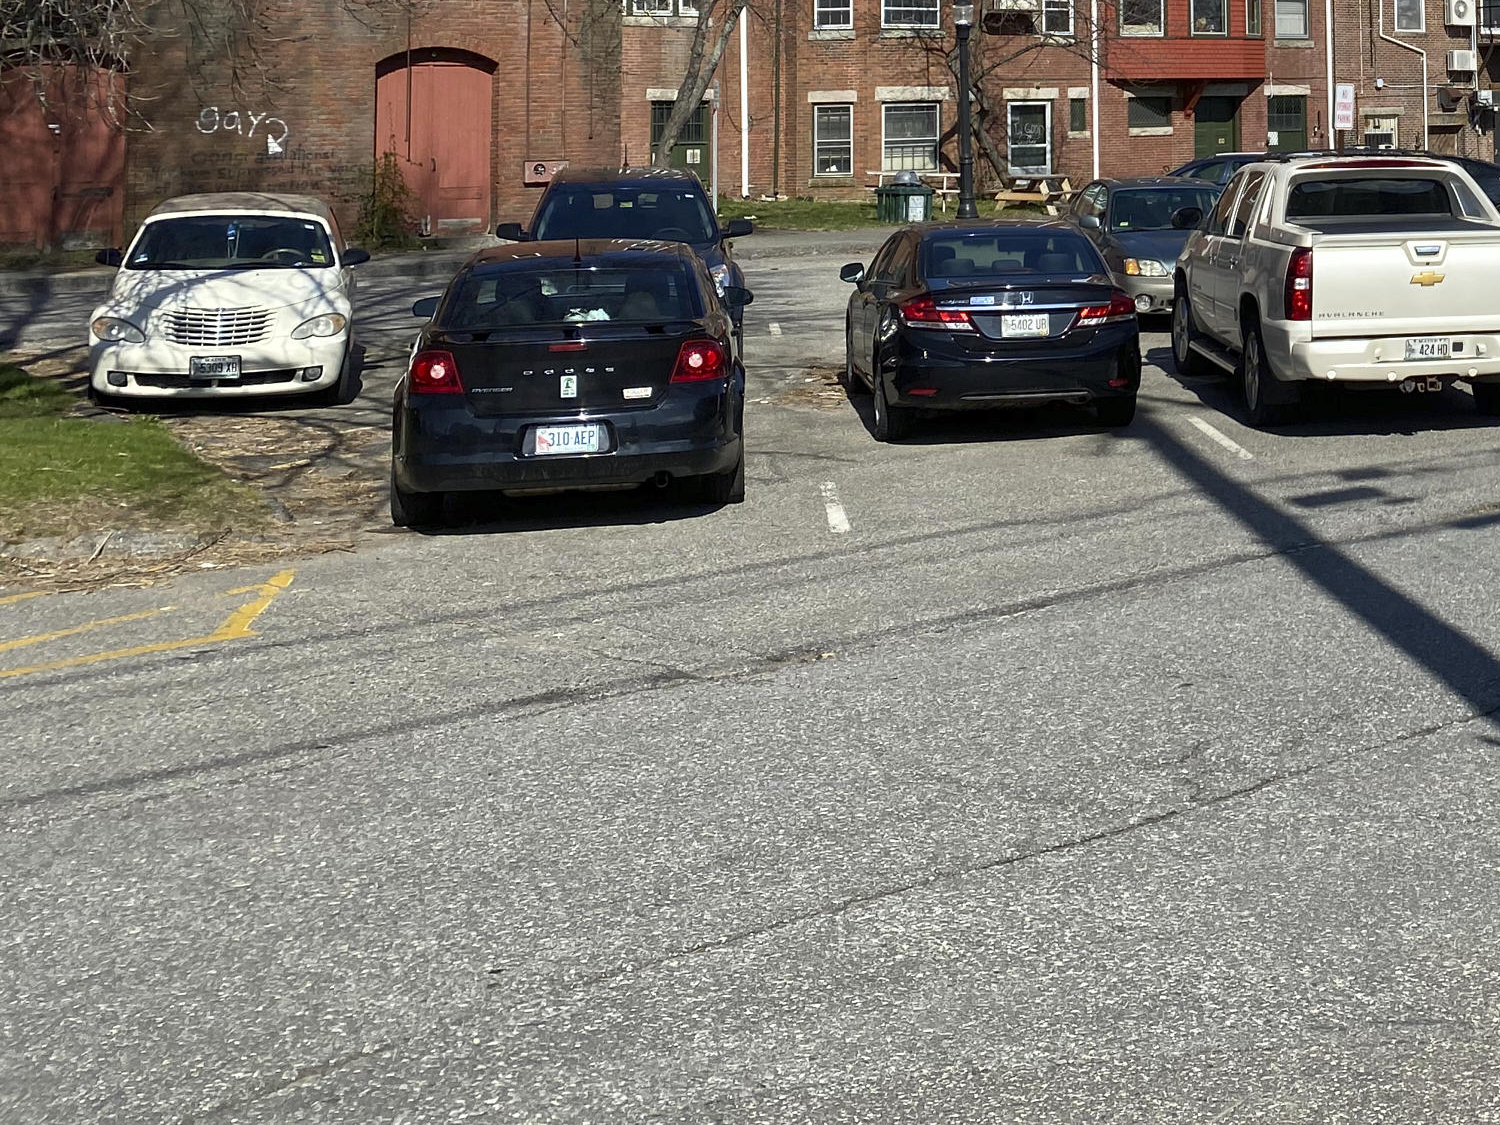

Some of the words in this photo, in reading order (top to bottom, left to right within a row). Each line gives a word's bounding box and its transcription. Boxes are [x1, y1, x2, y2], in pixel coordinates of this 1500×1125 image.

[1419, 343, 1435, 356] 424
[548, 432, 570, 447] 310
[574, 430, 595, 445] AEP
